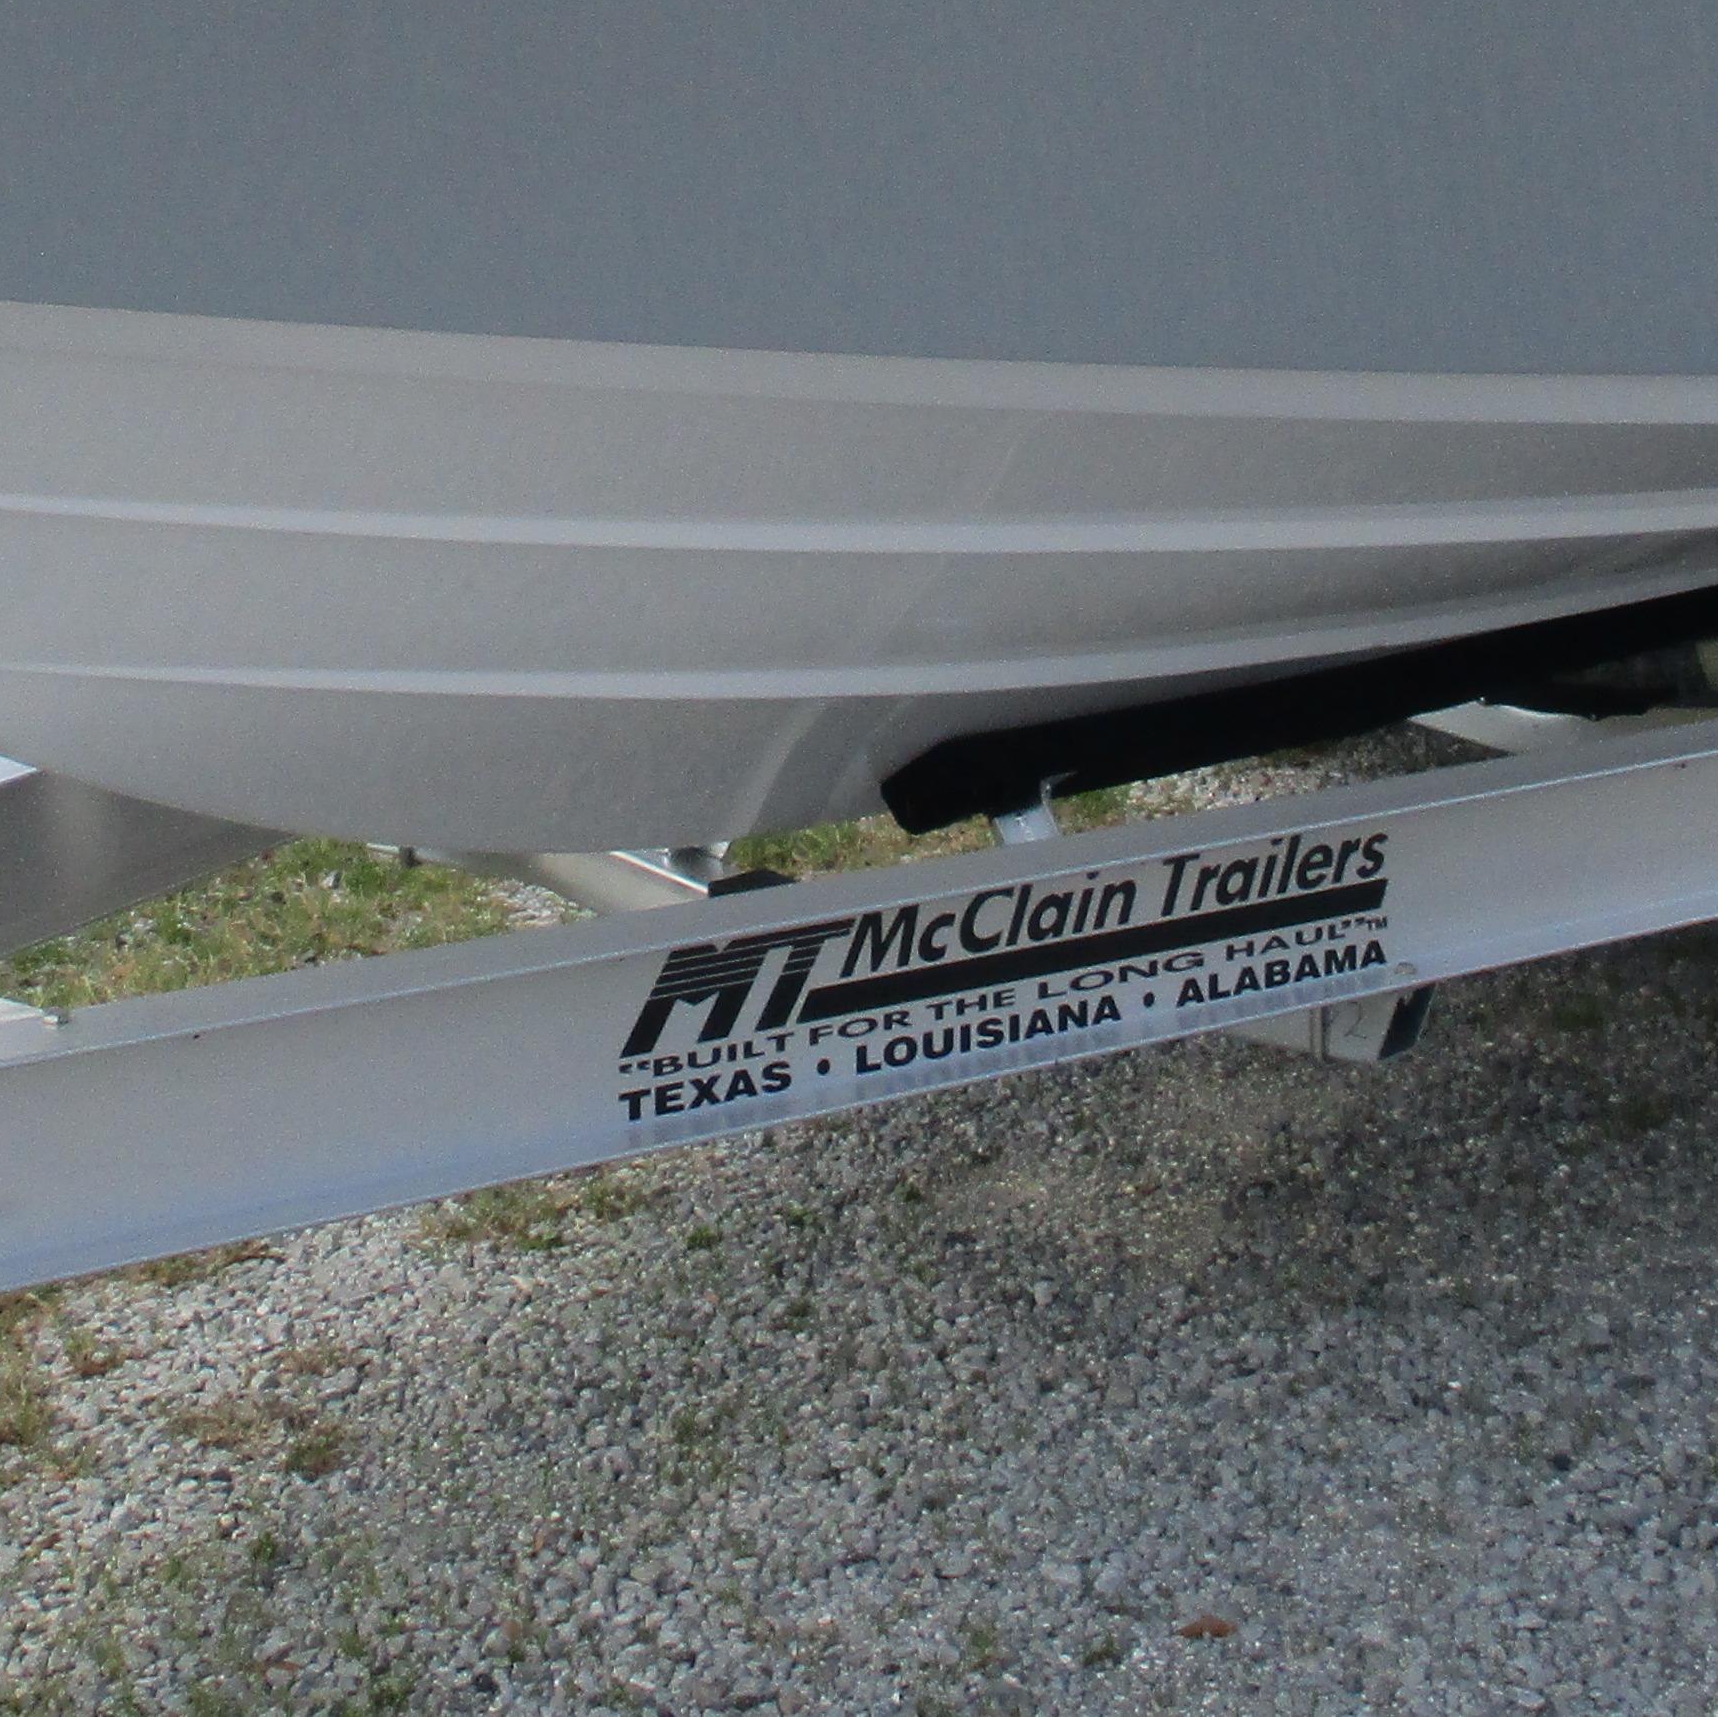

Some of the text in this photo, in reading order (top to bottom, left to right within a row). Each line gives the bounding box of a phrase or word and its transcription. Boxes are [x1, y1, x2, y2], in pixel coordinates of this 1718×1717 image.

[838, 833, 1389, 979] McClain Trailers
[618, 939, 1388, 1122] TEXAS LOUISIANA ALABAMA
[619, 917, 857, 1059] MT
[808, 1010, 913, 1047] FOR
[925, 987, 1016, 1022] THE
[1036, 951, 1206, 1001] LONG
